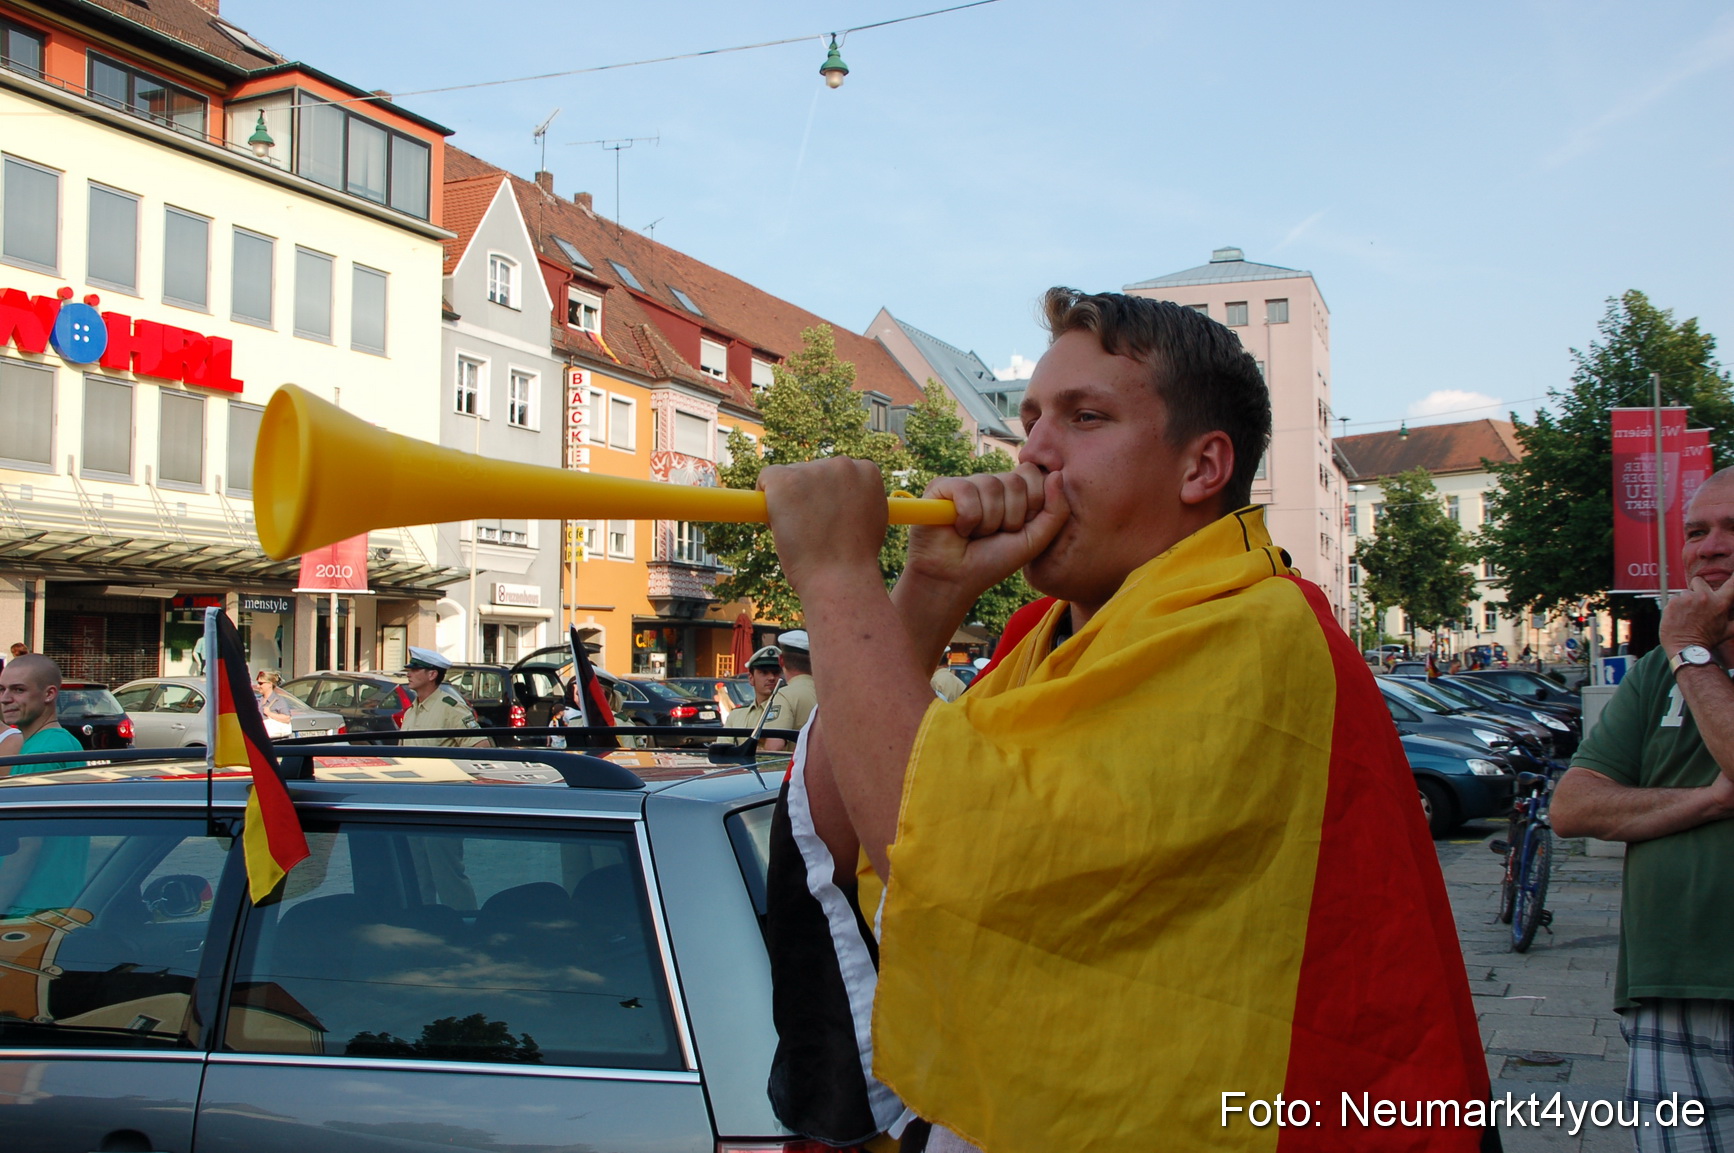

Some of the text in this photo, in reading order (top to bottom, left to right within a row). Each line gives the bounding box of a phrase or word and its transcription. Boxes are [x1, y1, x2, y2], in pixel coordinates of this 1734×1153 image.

[571, 372, 583, 473] BÄCKE
[567, 528, 584, 539] cfé
[315, 564, 353, 579] 2010
[244, 598, 288, 613] menstyle
